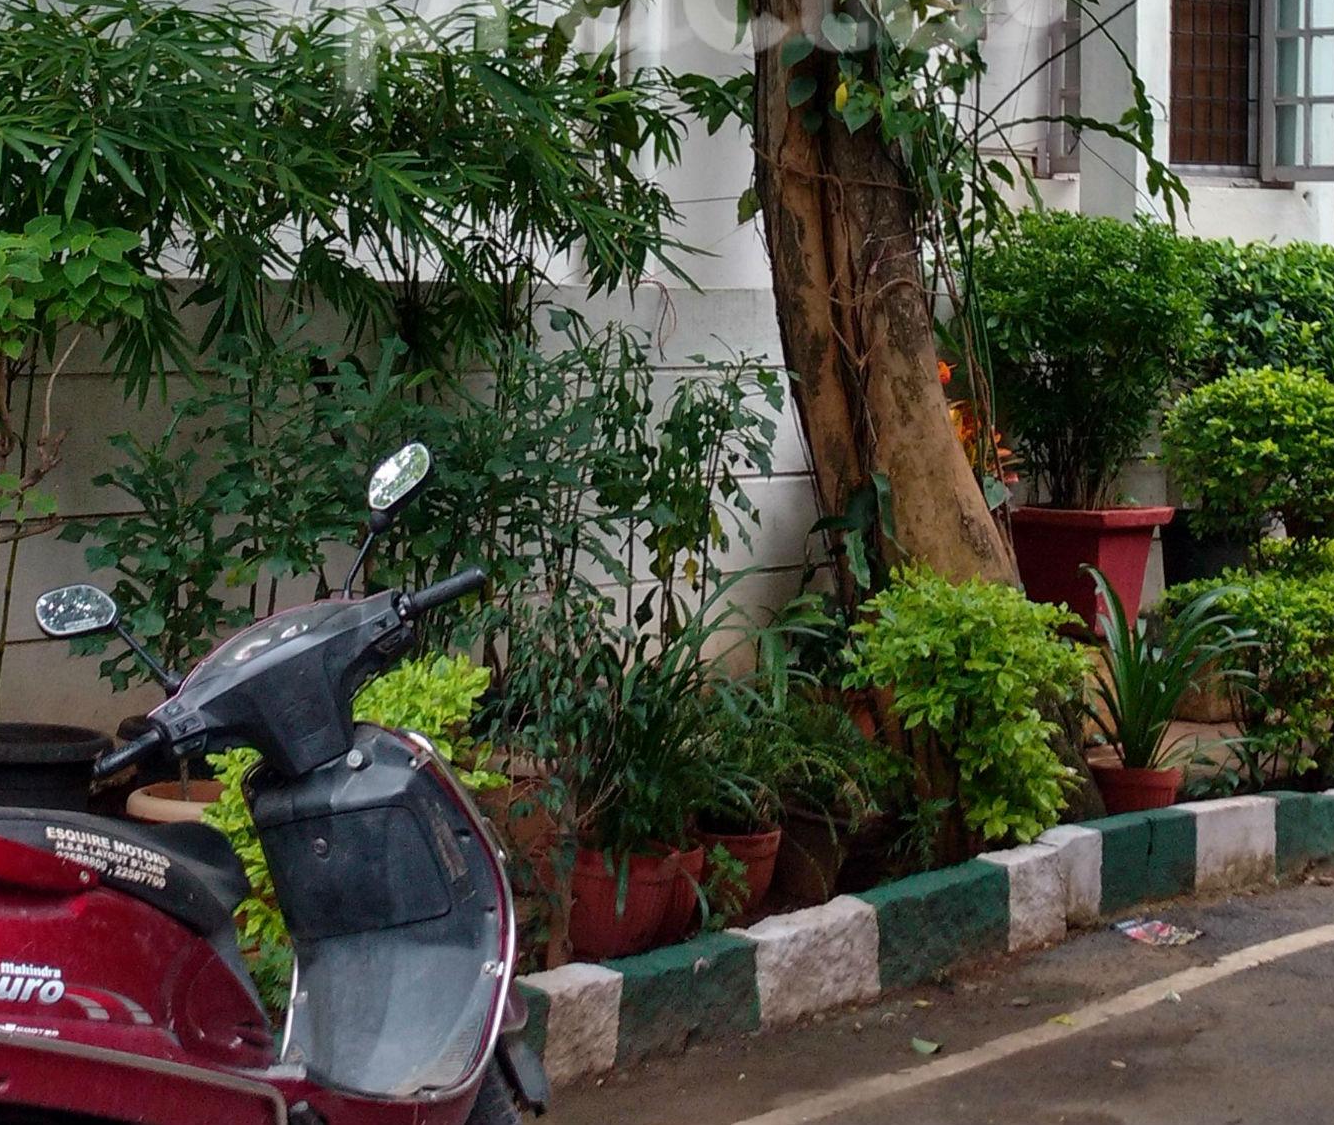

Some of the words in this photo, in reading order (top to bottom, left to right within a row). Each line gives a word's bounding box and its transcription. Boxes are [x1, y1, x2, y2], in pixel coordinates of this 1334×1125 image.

[46, 826, 111, 850] ESQUIRE
[113, 840, 170, 868] MOTORS
[89, 845, 129, 864] LAYOUT
[130, 859, 166, 876] B'LORE
[0, 961, 62, 978] Mahindra
